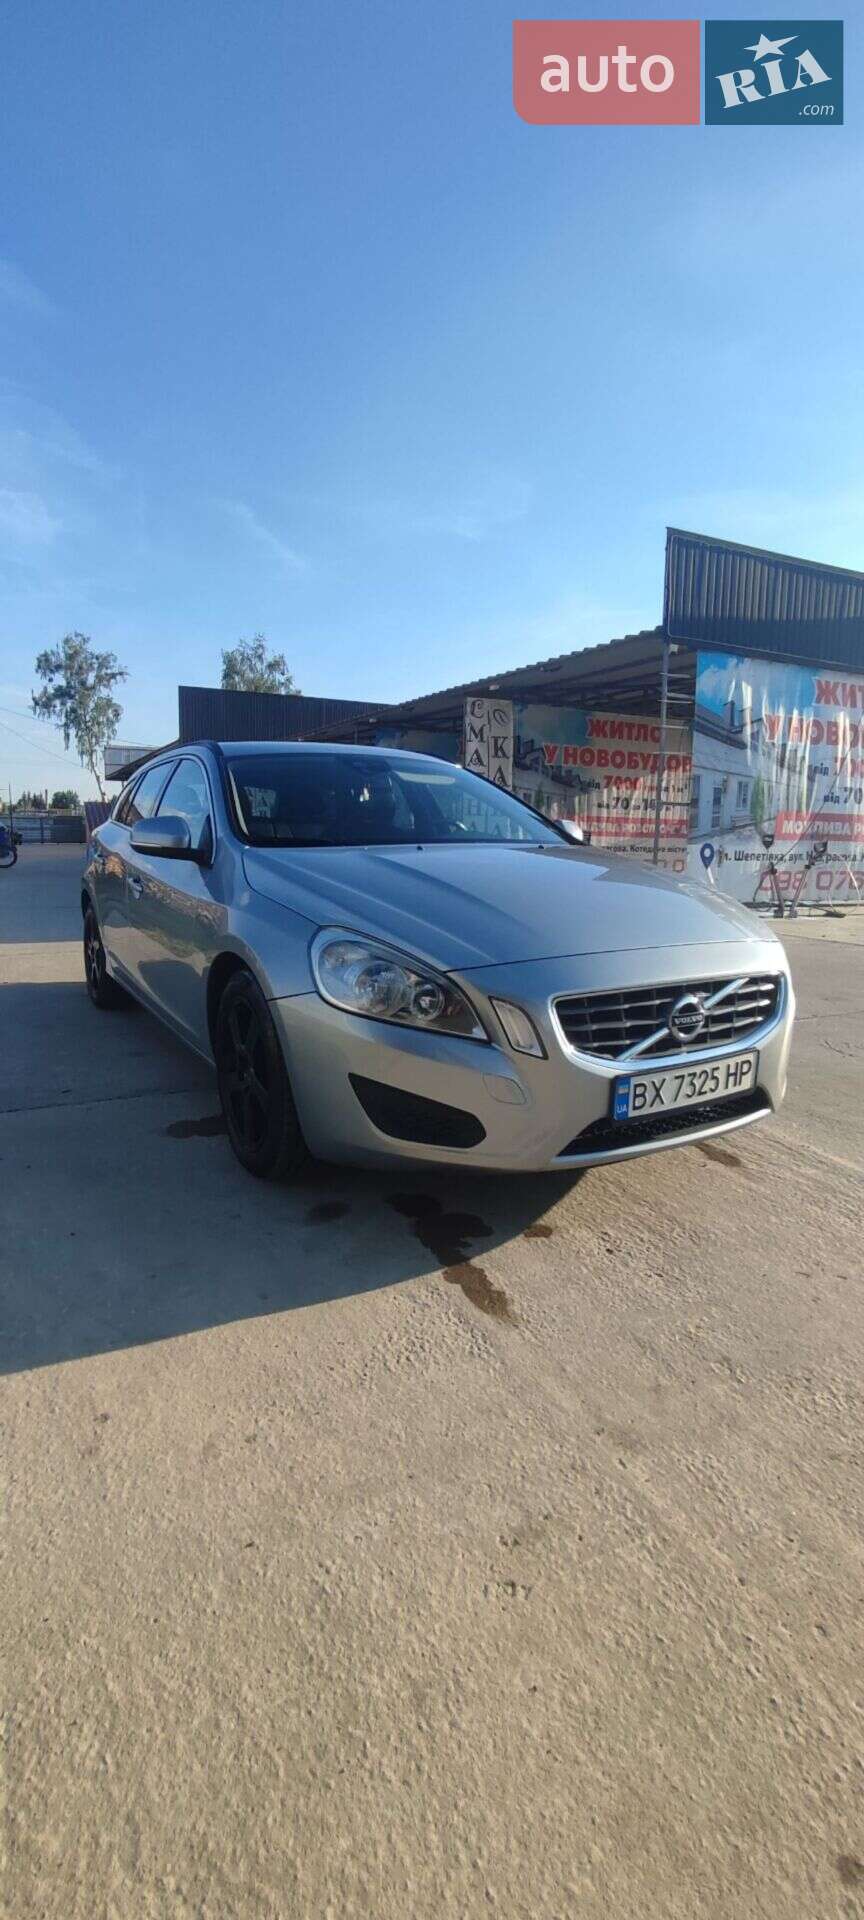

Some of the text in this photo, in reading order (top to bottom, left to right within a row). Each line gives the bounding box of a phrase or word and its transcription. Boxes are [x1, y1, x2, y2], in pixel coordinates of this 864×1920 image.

[787, 716, 864, 748] НОВО
[544, 744, 558, 764] У
[673, 1014, 704, 1025] VOLVO
[632, 1058, 752, 1111] BX 7325 HP
[616, 1104, 628, 1114] UA
